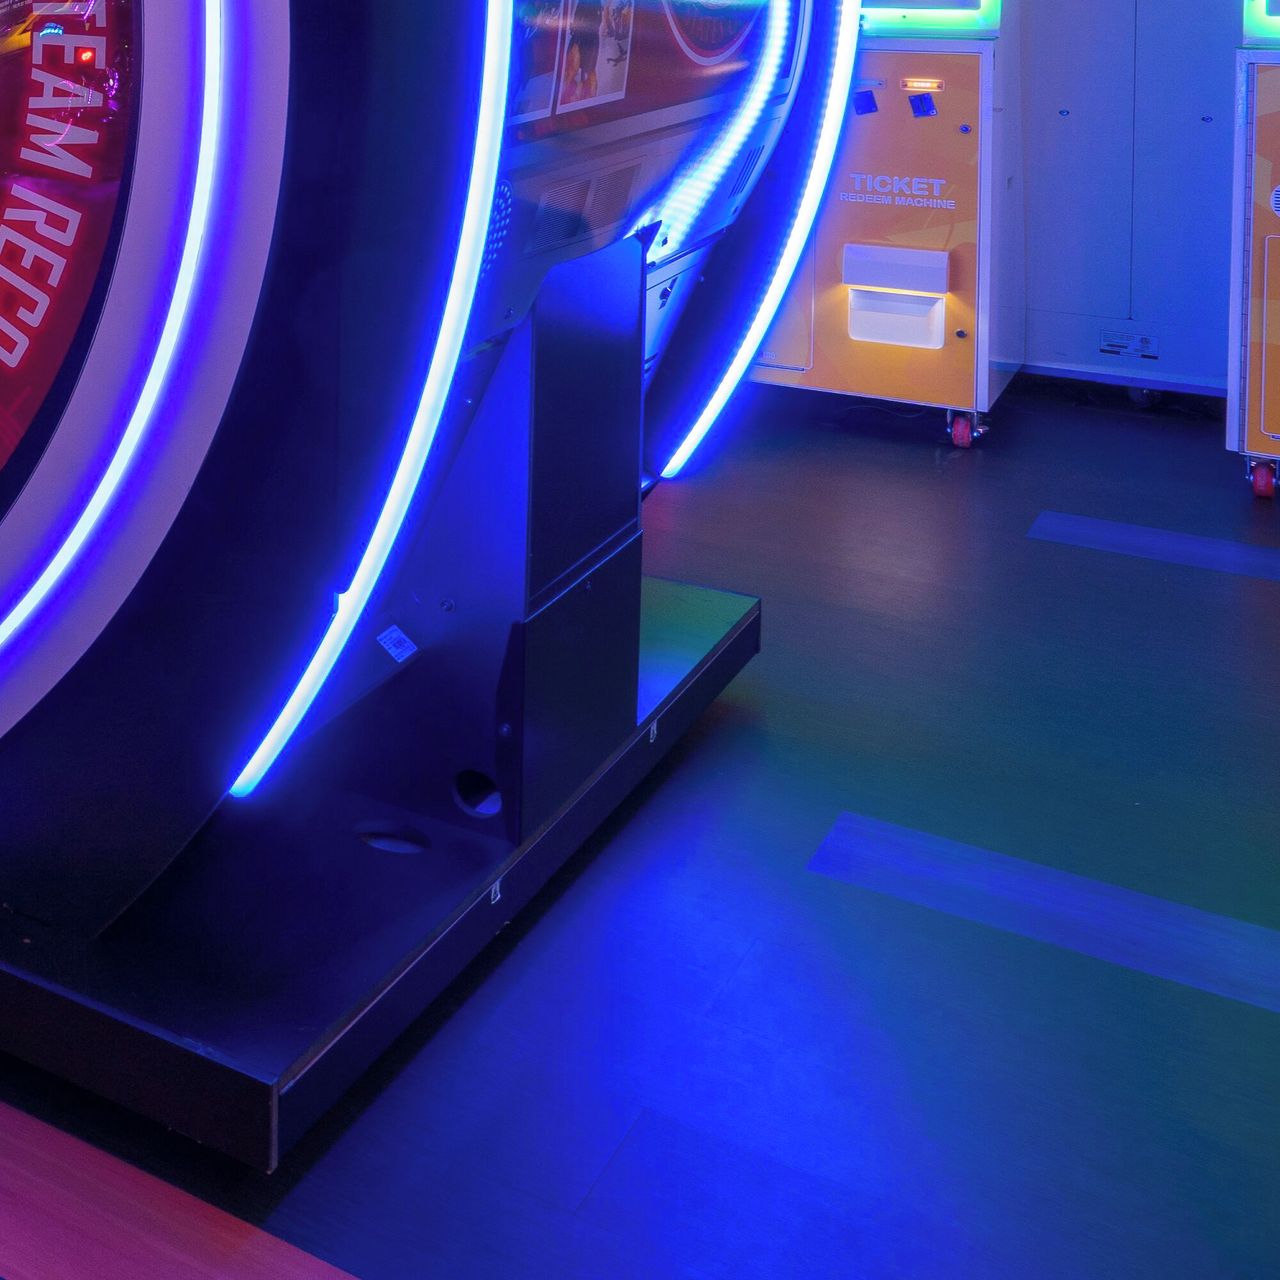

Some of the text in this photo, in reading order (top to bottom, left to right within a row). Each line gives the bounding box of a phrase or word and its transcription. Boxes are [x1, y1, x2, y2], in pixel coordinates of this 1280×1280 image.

[848, 173, 946, 196] TICKET
[840, 192, 956, 209] REDEEM MACHINE
